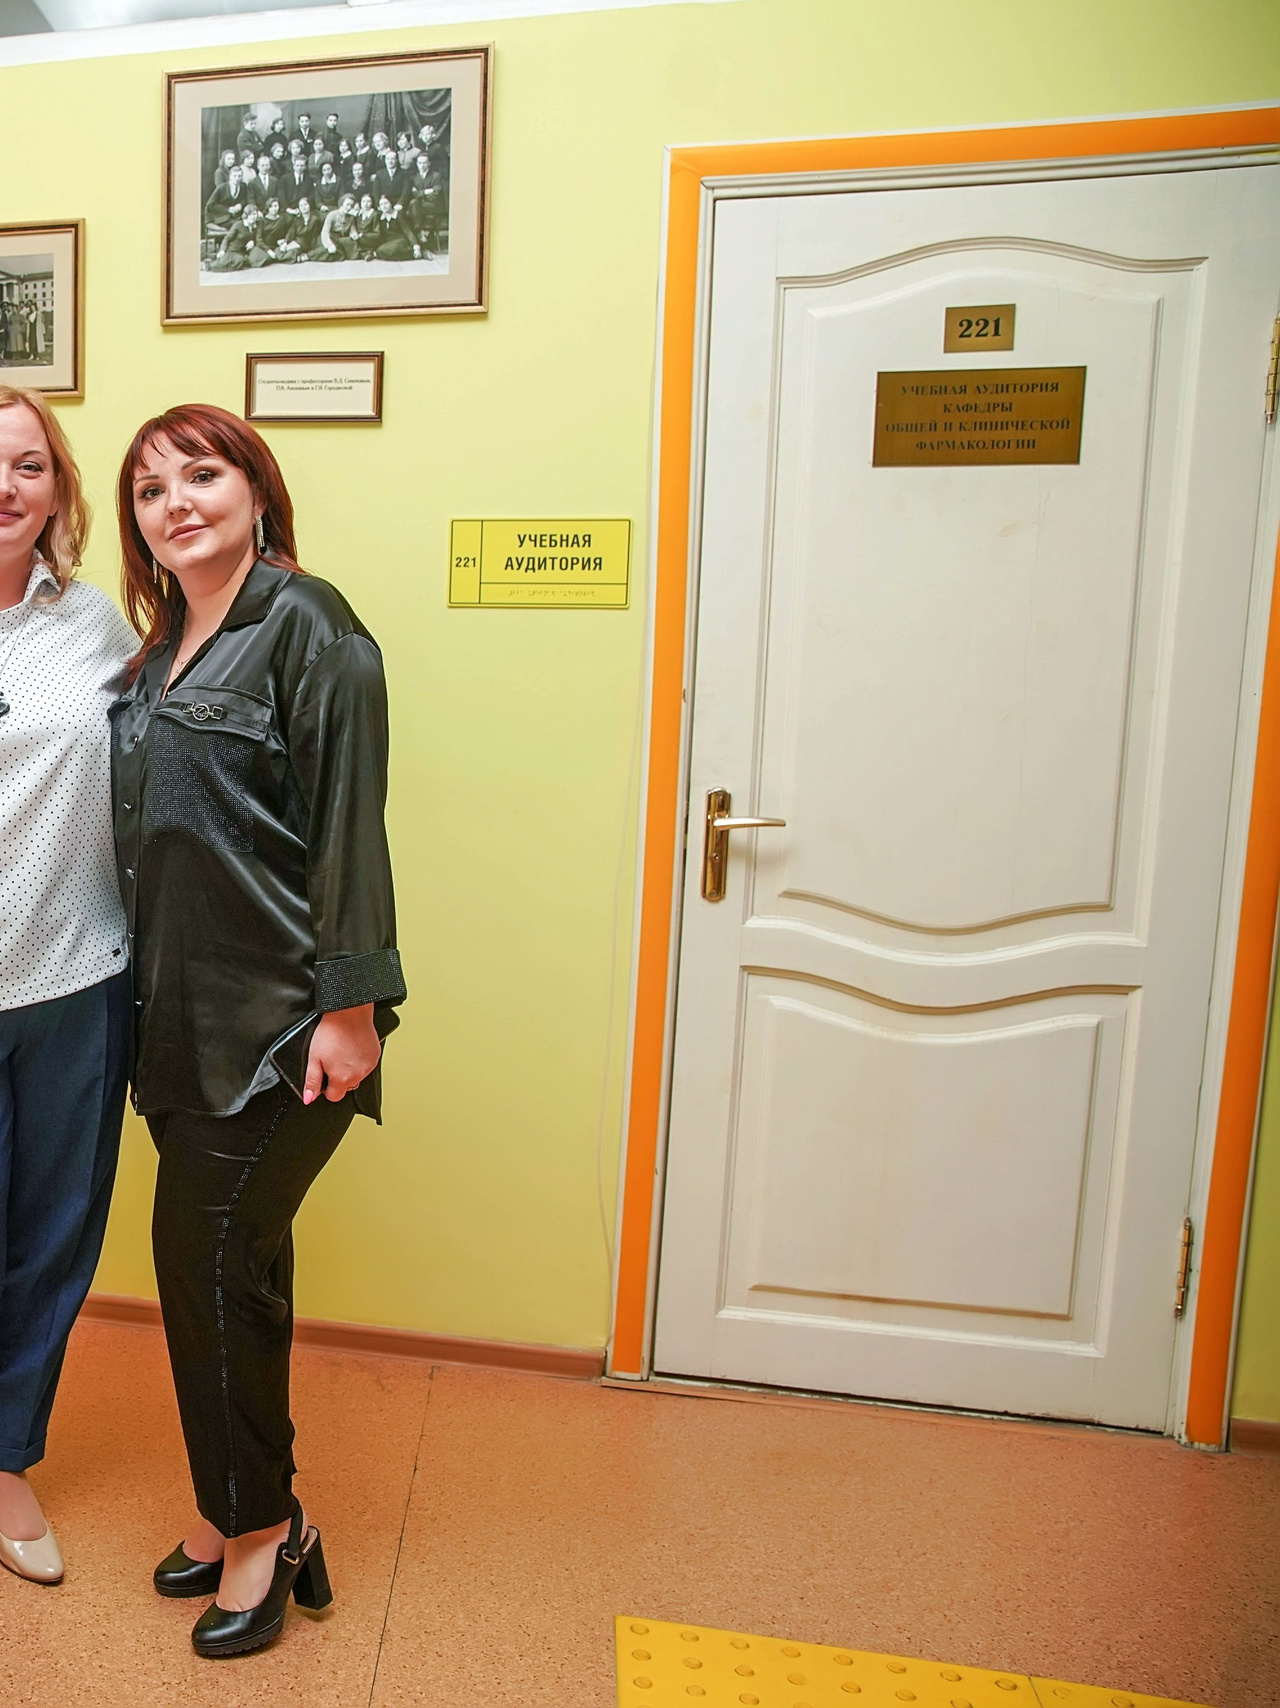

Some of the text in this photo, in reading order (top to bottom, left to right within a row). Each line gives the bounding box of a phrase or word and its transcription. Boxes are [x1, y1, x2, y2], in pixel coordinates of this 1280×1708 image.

[958, 317, 1002, 339] 221
[901, 382, 1059, 396] УЧЕБНАЯ АУДИТОРИЯ
[943, 401, 1014, 414] КАФЕДРЫ
[885, 417, 1070, 433] ОБЩЕЙ И КЛИНИЧЕСКОЙ
[916, 438, 1037, 451] ФАРМАКОЛОГИИ
[517, 533, 592, 548] УЧЕБНАЯ
[455, 556, 477, 568] 221
[504, 557, 603, 573] АУДИТОРИЯ
